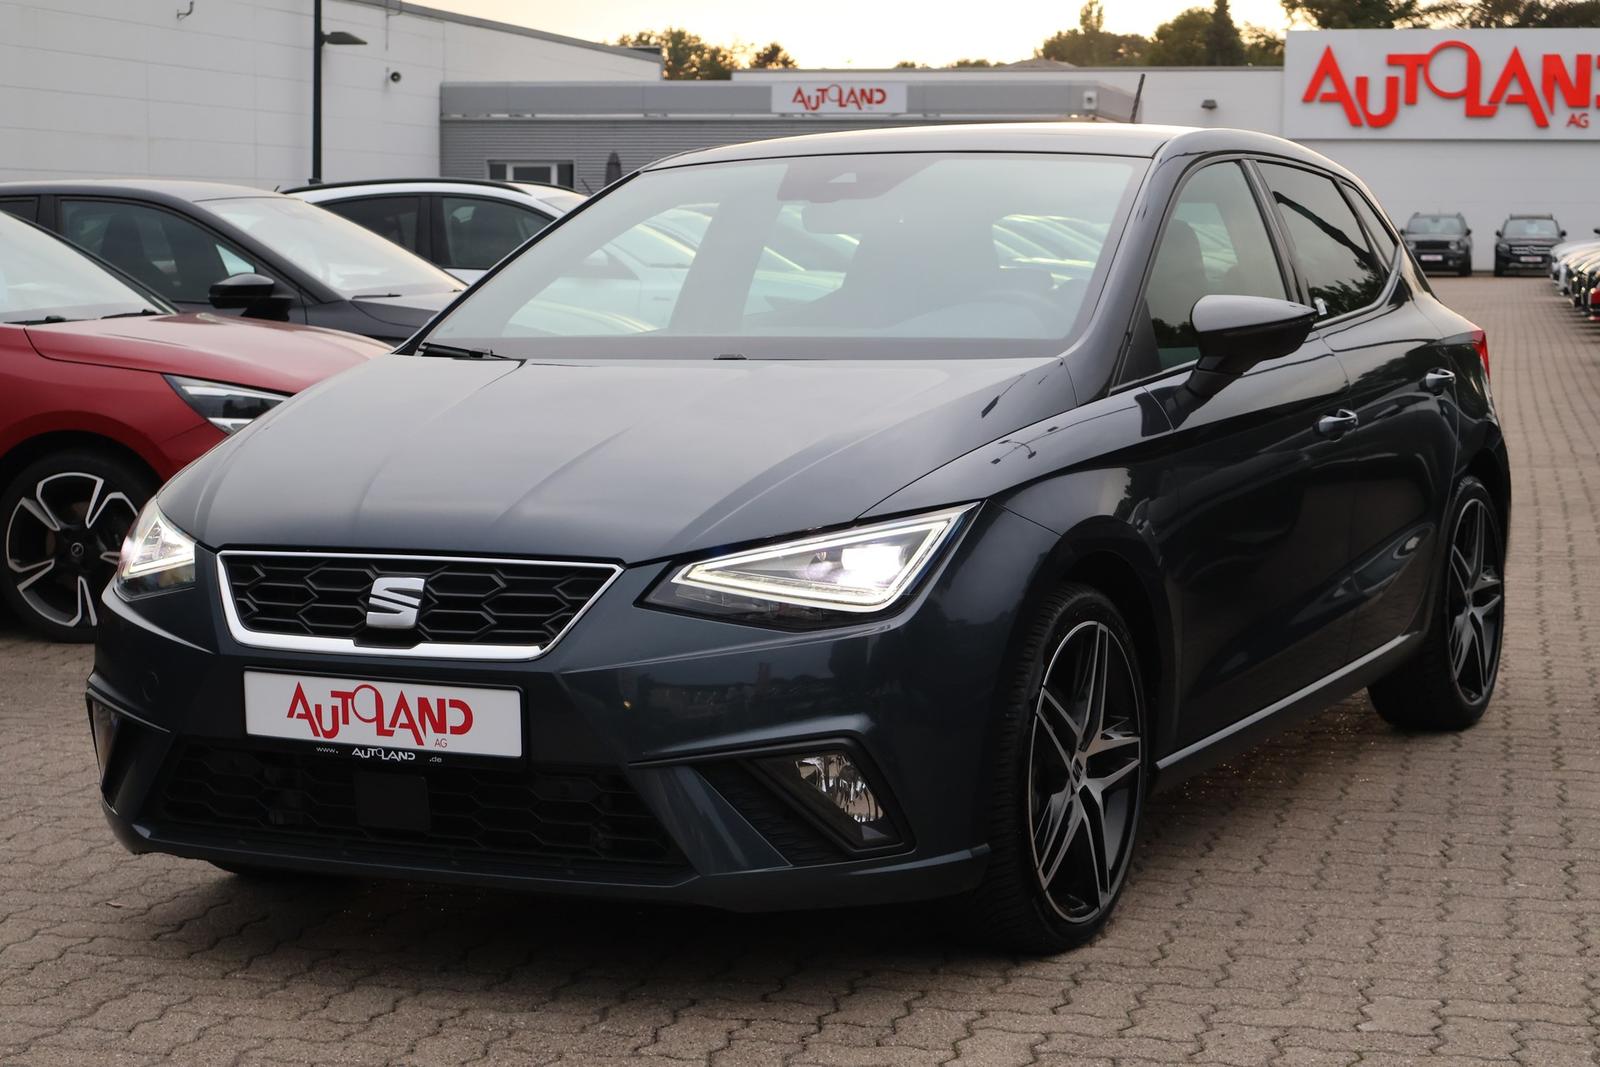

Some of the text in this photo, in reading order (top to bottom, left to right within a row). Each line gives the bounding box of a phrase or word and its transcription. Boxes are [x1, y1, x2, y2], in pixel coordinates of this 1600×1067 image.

[1302, 40, 1600, 128] AUTOLAN
[792, 84, 887, 111] AUTOLAND
[1567, 113, 1589, 128] AG
[286, 681, 474, 747] AUTOLAND
[316, 746, 339, 754] www.
[351, 747, 416, 761] AUTOLAND
[434, 738, 448, 748] AG
